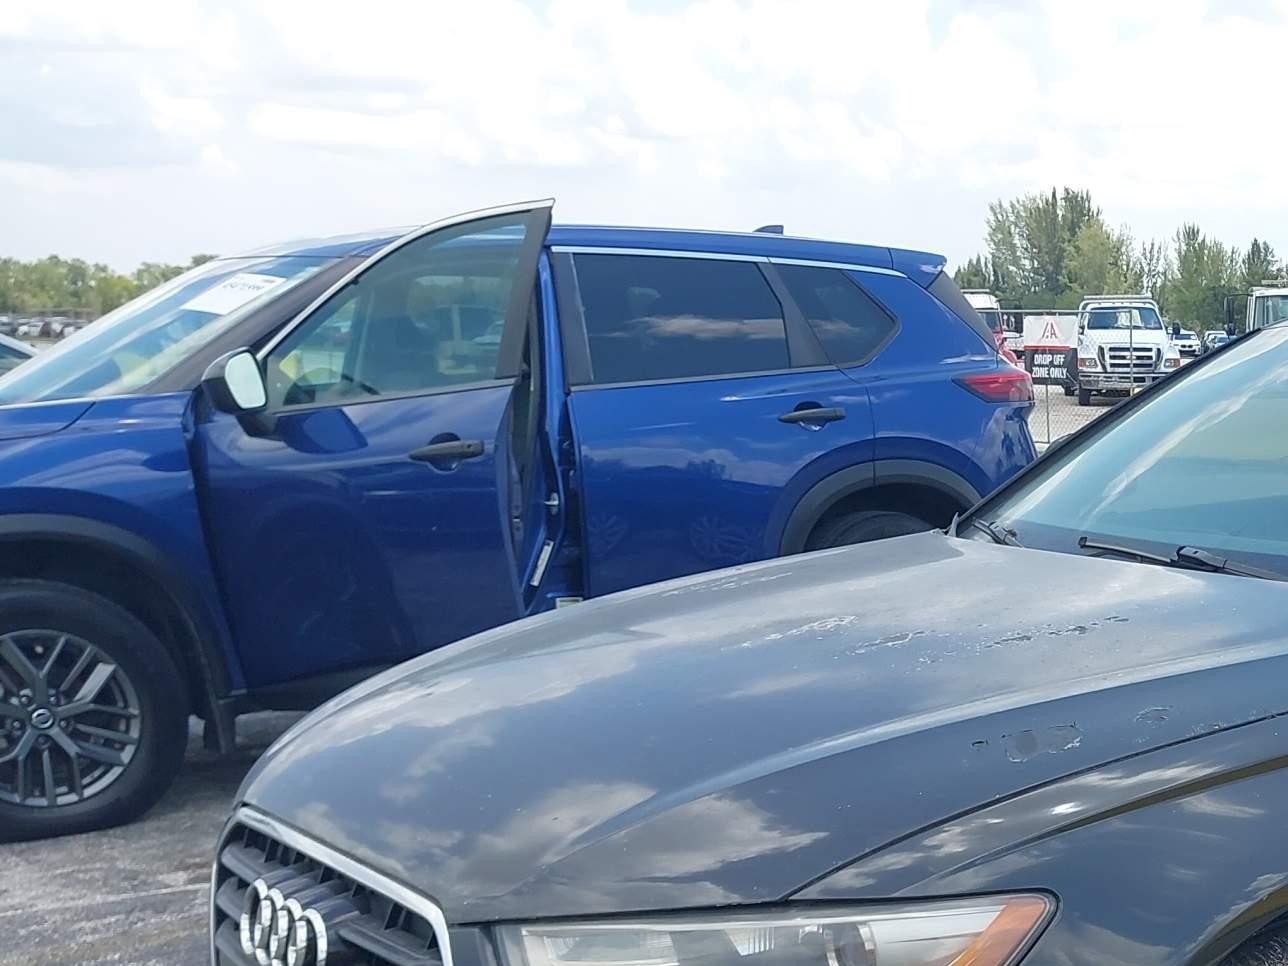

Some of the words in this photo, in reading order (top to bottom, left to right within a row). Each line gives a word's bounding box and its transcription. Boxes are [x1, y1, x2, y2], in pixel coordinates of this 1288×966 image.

[1034, 354, 1052, 365] DROP
[1053, 354, 1065, 365] OFF
[1032, 367, 1049, 378] ZONE
[1050, 367, 1067, 379] ONLY
